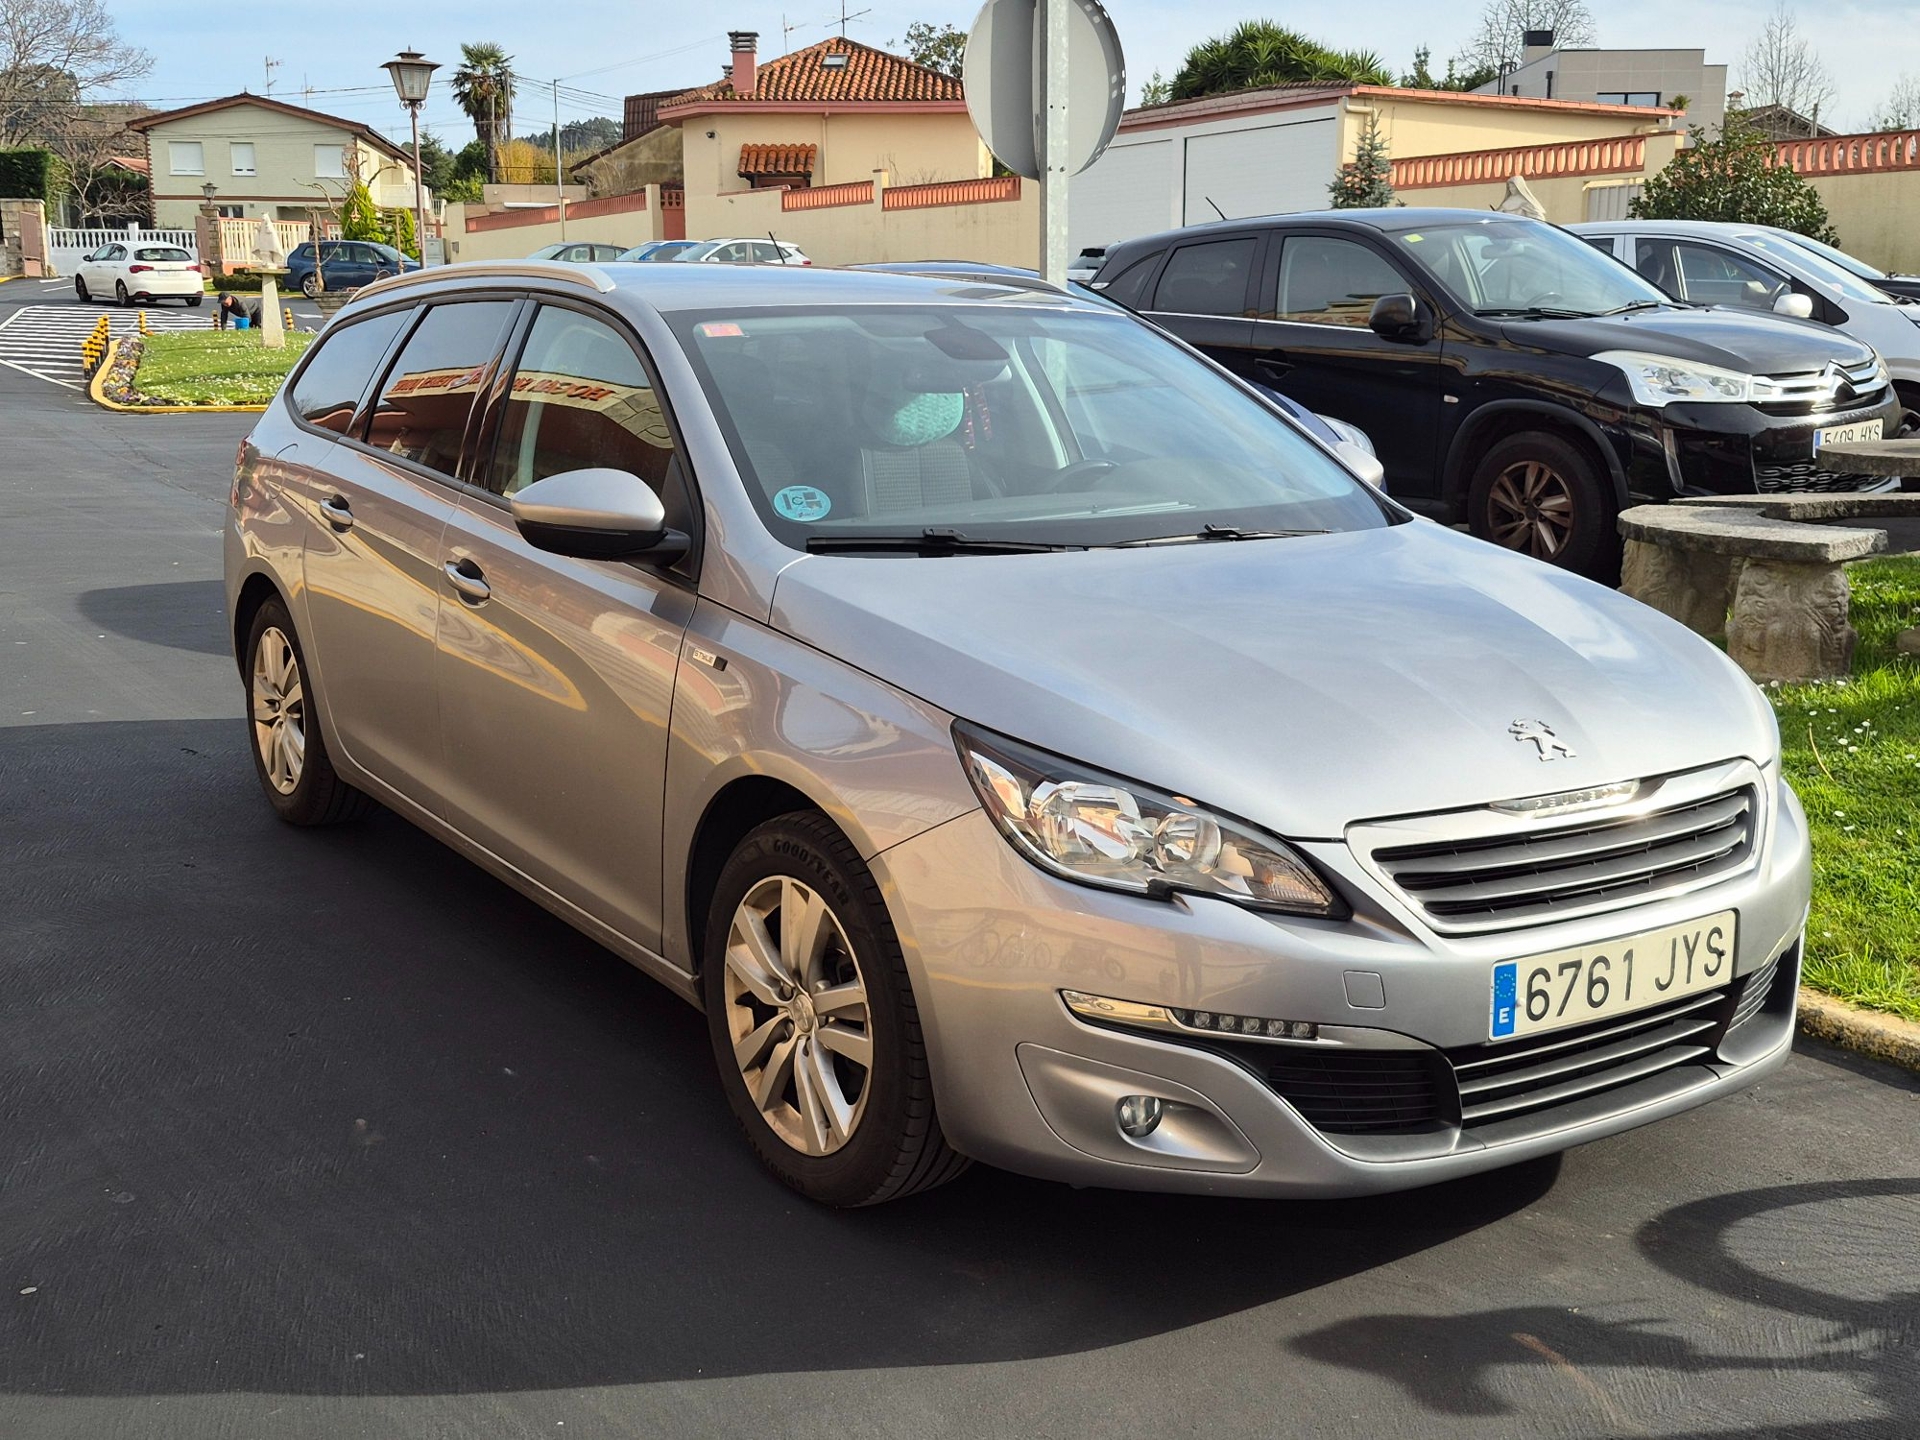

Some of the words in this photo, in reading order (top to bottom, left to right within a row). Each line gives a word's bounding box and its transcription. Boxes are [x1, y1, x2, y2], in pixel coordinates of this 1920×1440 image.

[773, 838, 849, 906] GOODYEAR
[1526, 948, 1634, 1022] 6761
[1654, 926, 1724, 992] JYS
[1498, 1007, 1510, 1024] E
